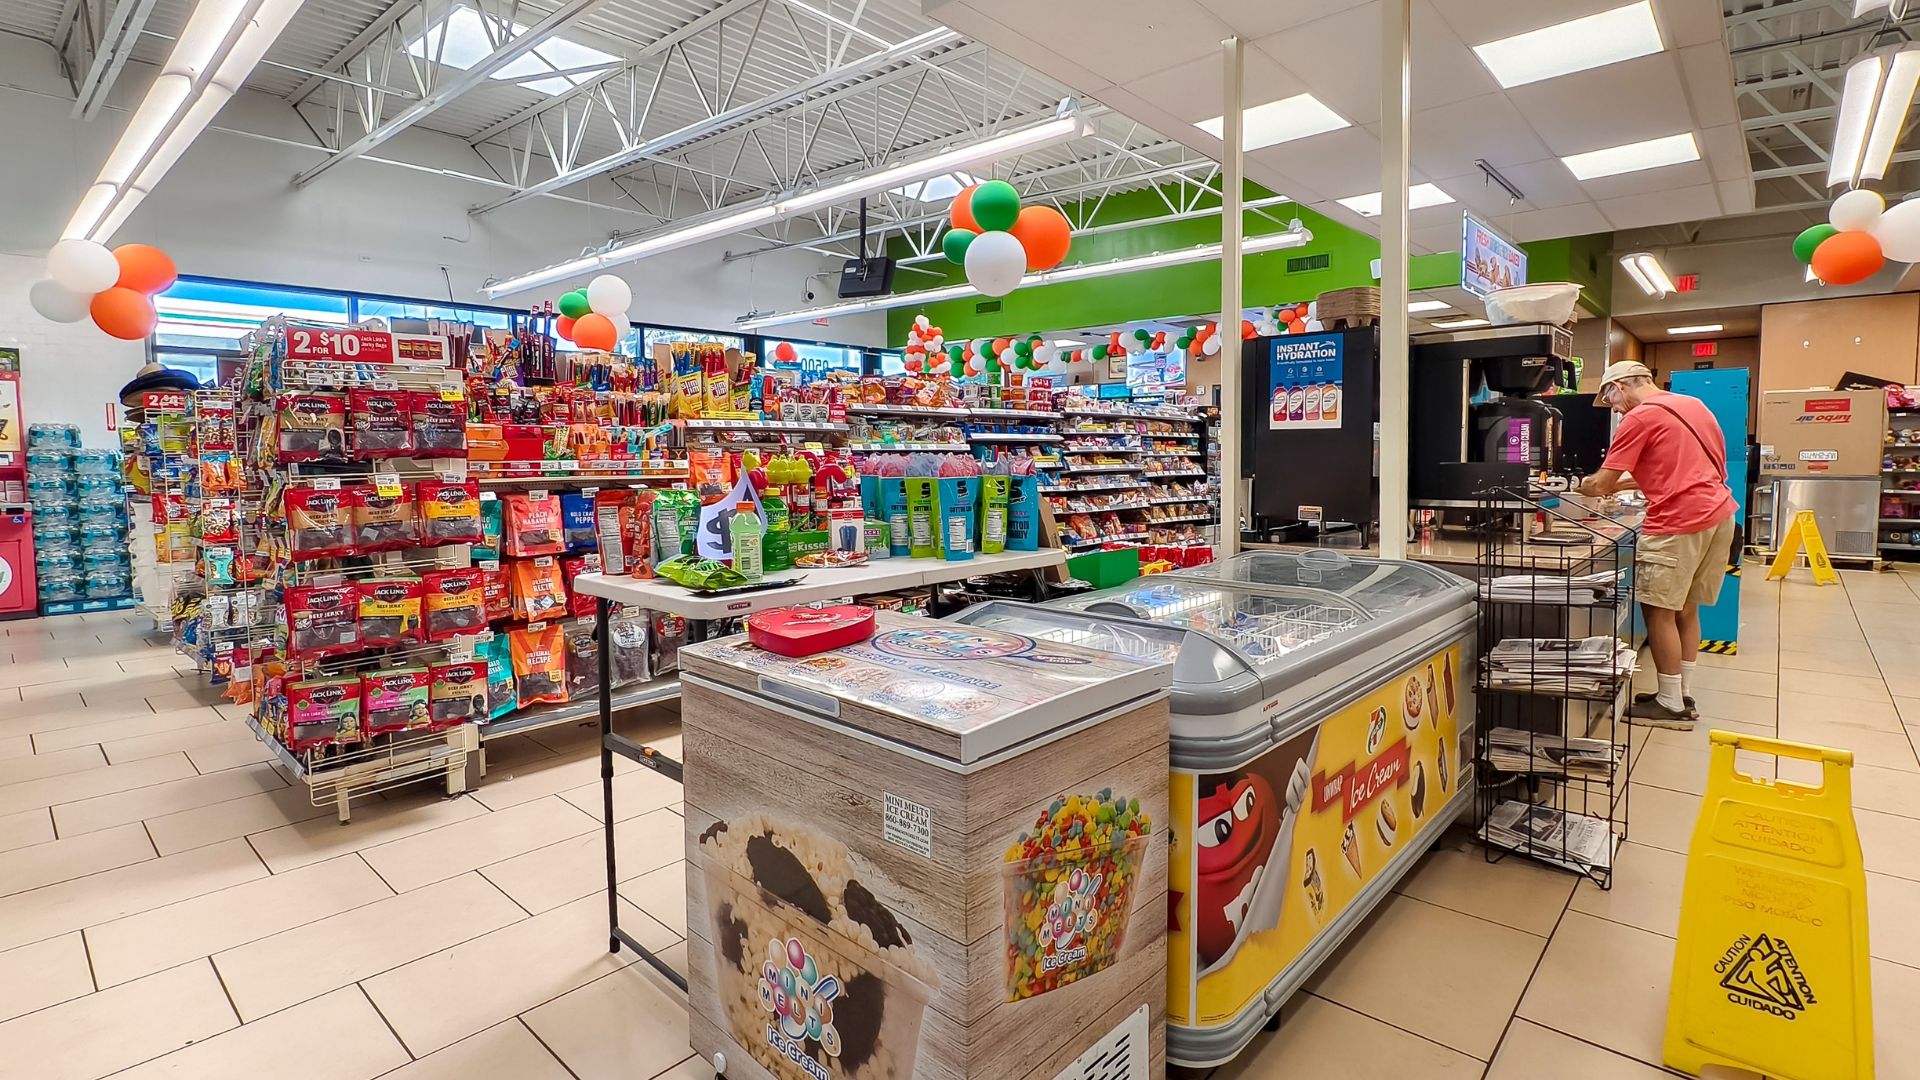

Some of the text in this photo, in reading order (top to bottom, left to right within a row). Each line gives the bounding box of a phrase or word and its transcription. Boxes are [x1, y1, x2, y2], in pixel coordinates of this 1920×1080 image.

[293, 331, 360, 356] 2 FOR $10
[1276, 342, 1320, 353] INSTANT
[1276, 349, 1336, 361] HYDRATION
[149, 394, 159, 406] 2
[307, 595, 322, 604] JACK
[309, 691, 325, 699] JACK
[382, 680, 397, 688] JACK
[1366, 759, 1400, 799] Cream
[885, 794, 929, 818] MINI MELTS
[886, 804, 928, 827] ICE CREAM
[885, 812, 929, 837] 860-889-7300
[1732, 820, 1824, 845] ATTENTION
[1740, 832, 1816, 855] CUIDADO
[1043, 948, 1085, 970] Ice Cream
[1714, 934, 1751, 974] CAUTION
[1773, 937, 1818, 1004] ATTENTION
[1727, 993, 1796, 1020] CUIDADO
[767, 1025, 829, 1080] Ice Cream
